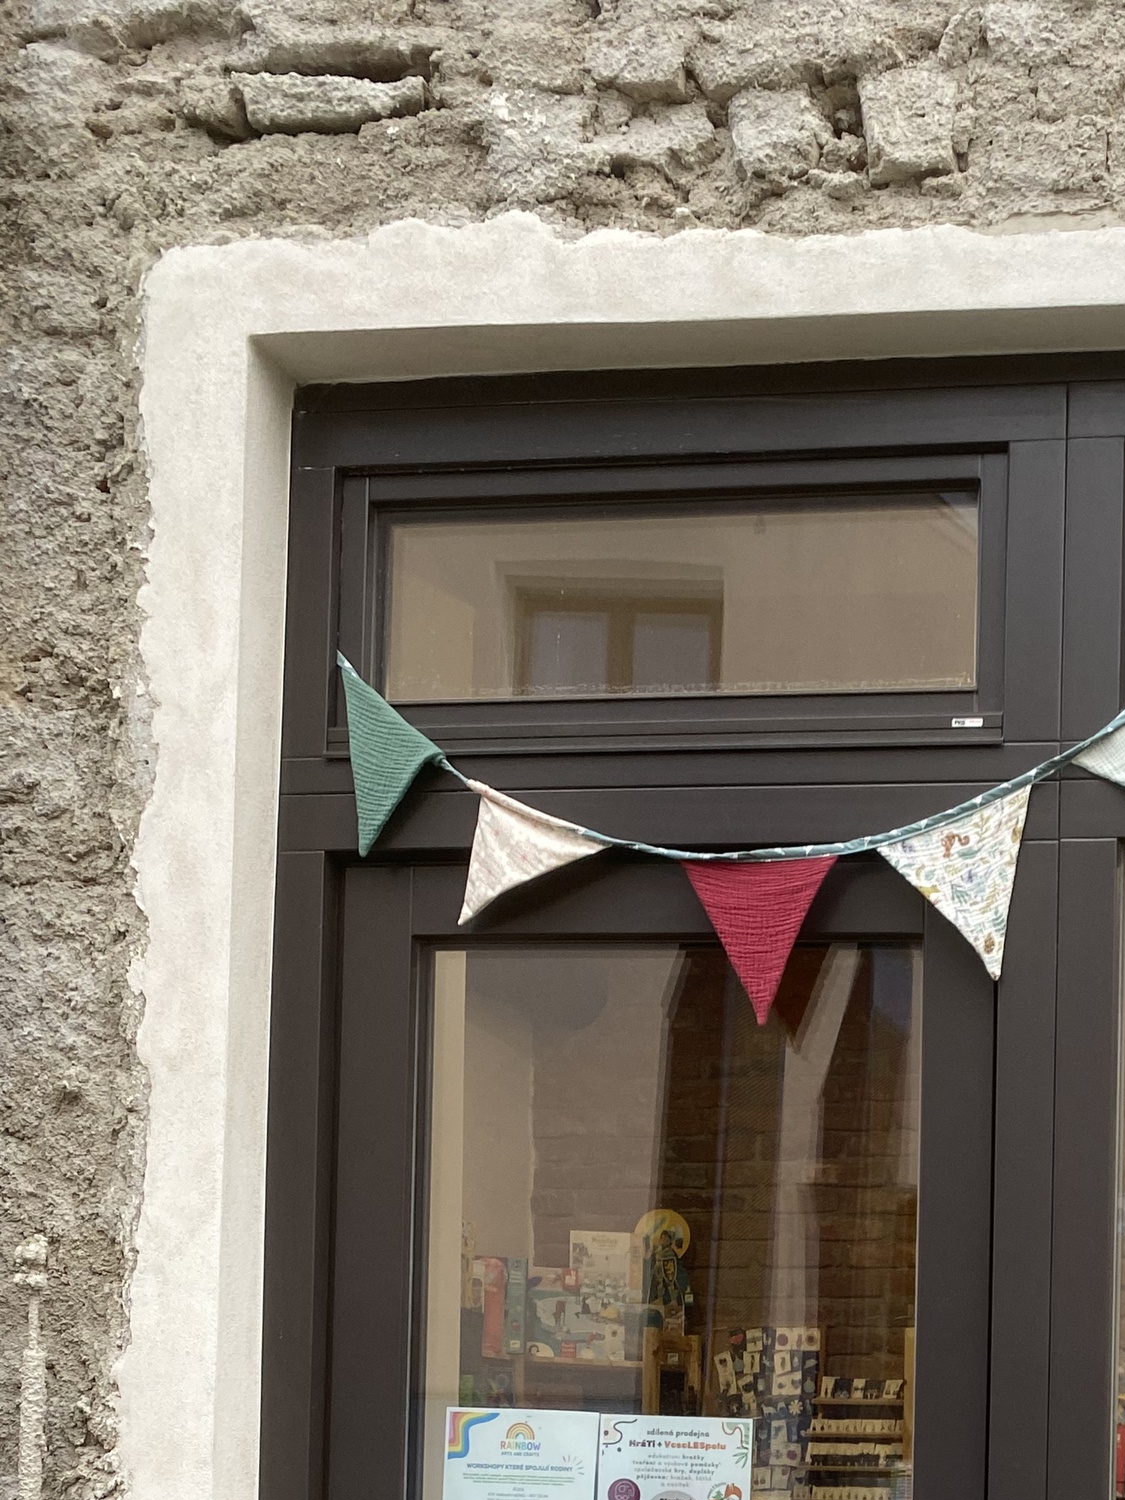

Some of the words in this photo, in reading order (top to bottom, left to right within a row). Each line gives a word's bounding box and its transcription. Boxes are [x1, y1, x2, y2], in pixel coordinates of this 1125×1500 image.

[647, 1428, 674, 1436] sdílená
[676, 1429, 710, 1439] prodejna
[500, 1441, 541, 1451] RAINBOW
